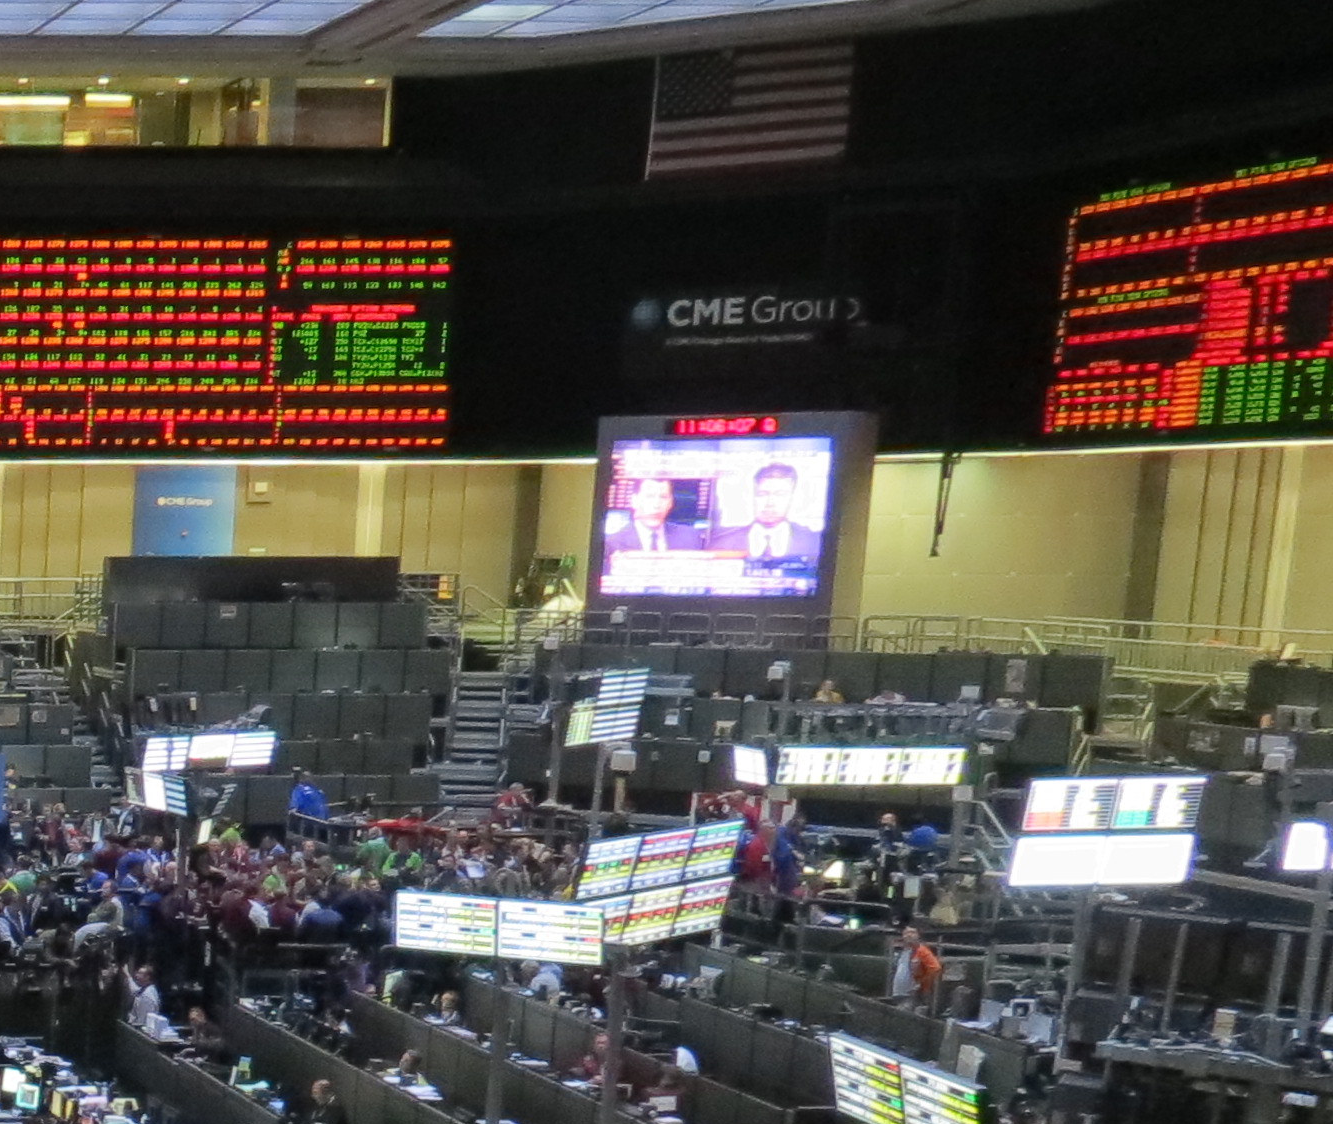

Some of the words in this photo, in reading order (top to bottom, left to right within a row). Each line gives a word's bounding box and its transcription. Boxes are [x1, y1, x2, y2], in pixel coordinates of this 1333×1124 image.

[667, 297, 746, 326] CME
[166, 497, 185, 505] CME
[186, 497, 213, 507] Group
